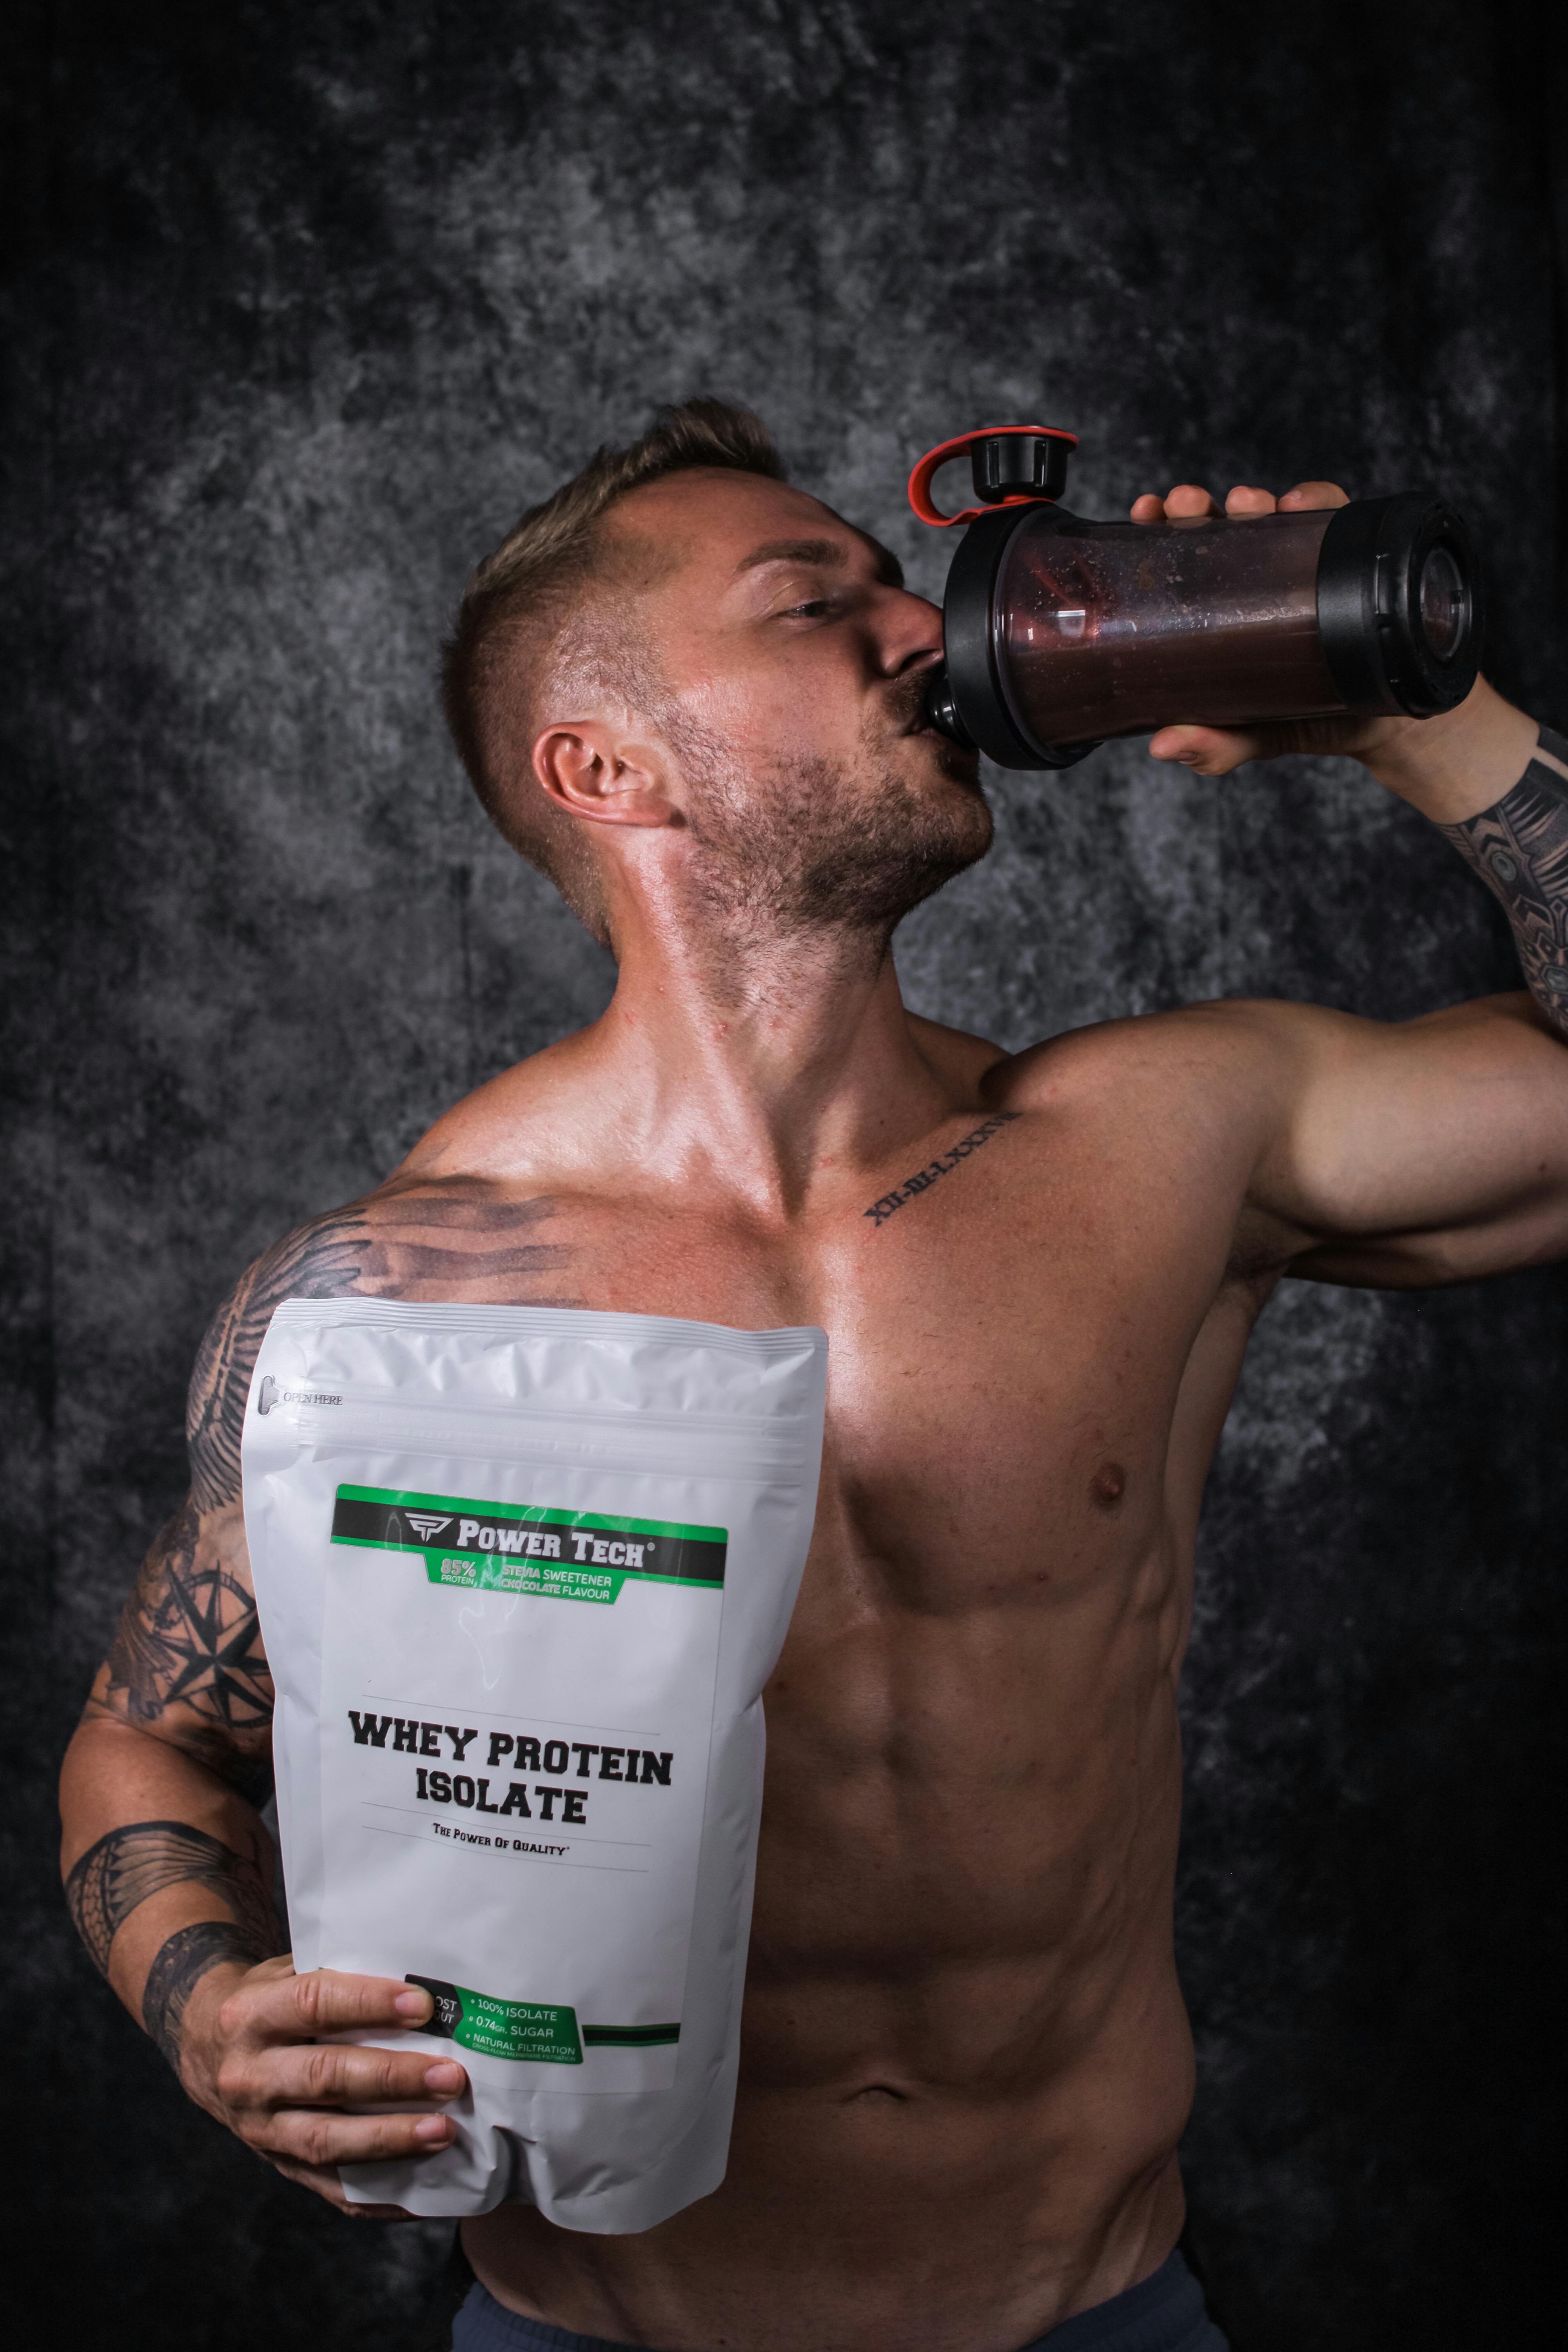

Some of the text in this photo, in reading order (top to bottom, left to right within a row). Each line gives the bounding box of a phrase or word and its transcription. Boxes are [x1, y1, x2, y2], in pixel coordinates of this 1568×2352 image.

[284, 1392, 343, 1405] OPEN HERE
[457, 1519, 561, 1558] POWER
[441, 1558, 477, 1577] 85%
[502, 1564, 612, 1587] STEVIA SWEETENER
[441, 1575, 474, 1585] PROTEIN
[501, 1579, 610, 1600] CHOCOLATE FLAVOUR
[348, 1711, 674, 1786] WHEY PROTEIN
[416, 1768, 588, 1825] ISOLATE
[435, 1996, 457, 2011] OST
[478, 1999, 558, 2021] 100% ISOLATE
[511, 2025, 554, 2038] SUGAR
[473, 2033, 575, 2055] NATURAL FILTRATION
